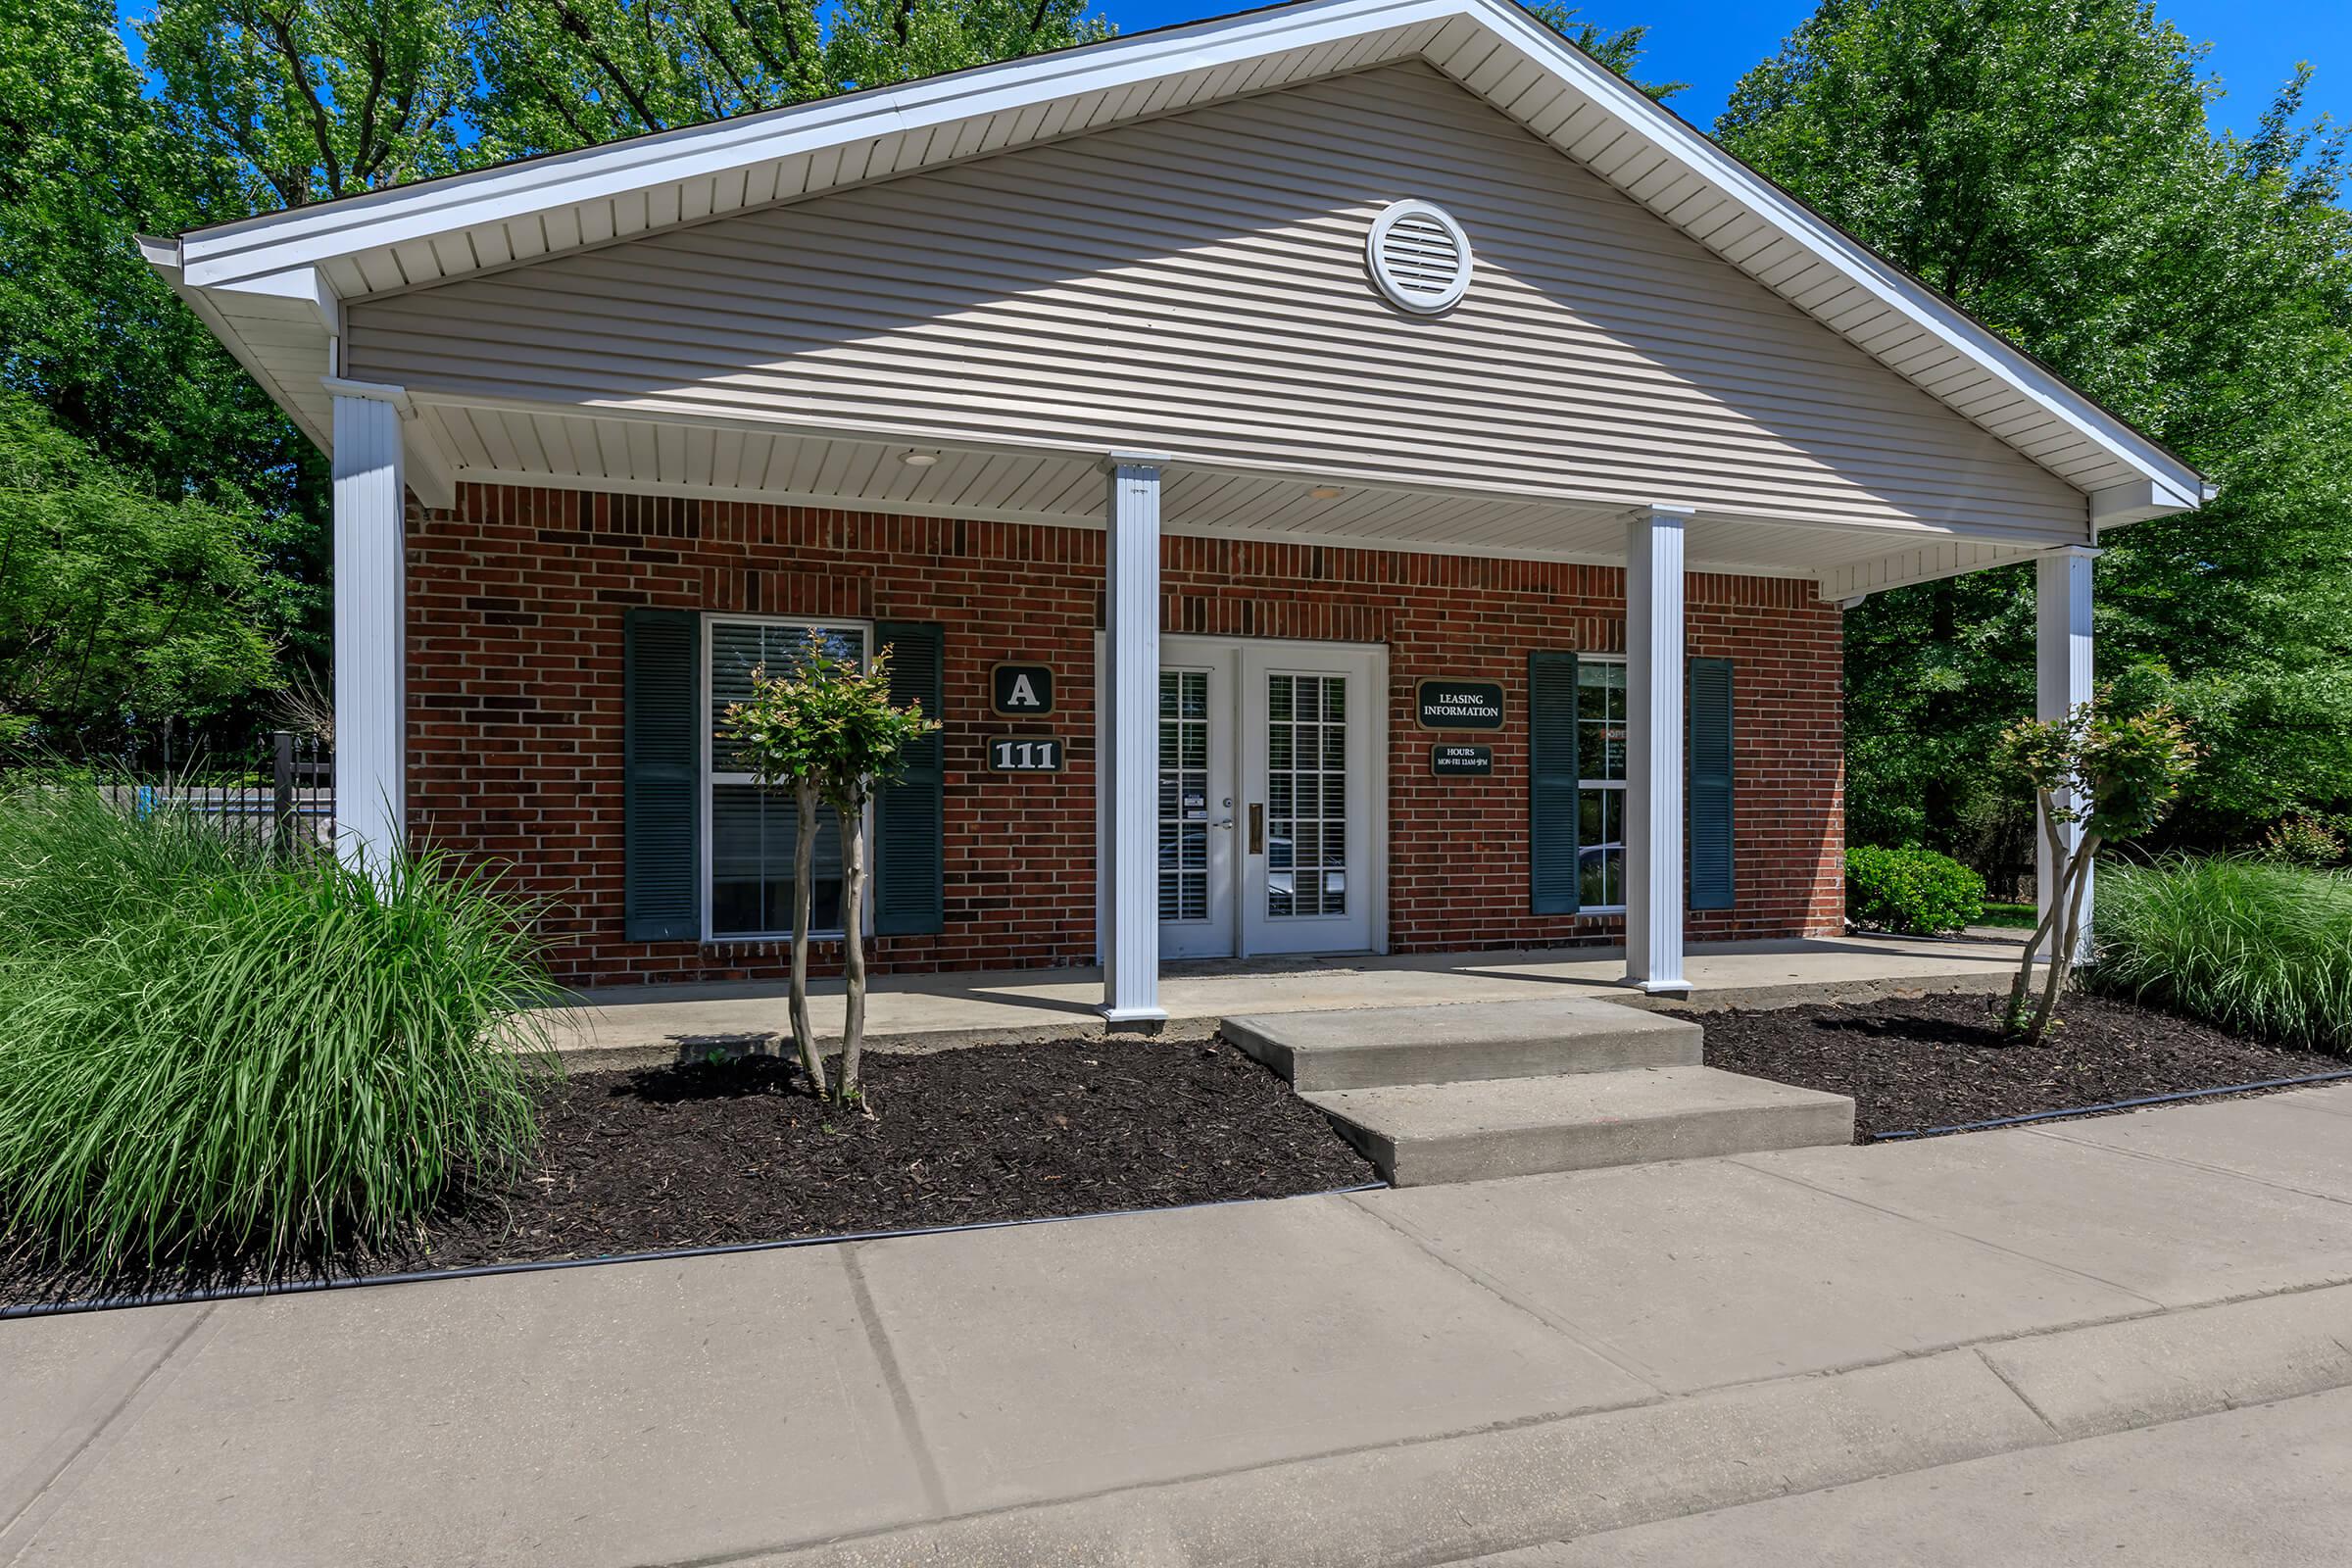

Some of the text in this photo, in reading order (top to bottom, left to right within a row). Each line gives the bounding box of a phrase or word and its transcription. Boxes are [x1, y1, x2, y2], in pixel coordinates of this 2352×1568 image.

[1007, 674, 1041, 706] A
[1440, 694, 1484, 705] LEASING
[1424, 706, 1498, 716] INFORMATION
[996, 742, 1055, 768] 111
